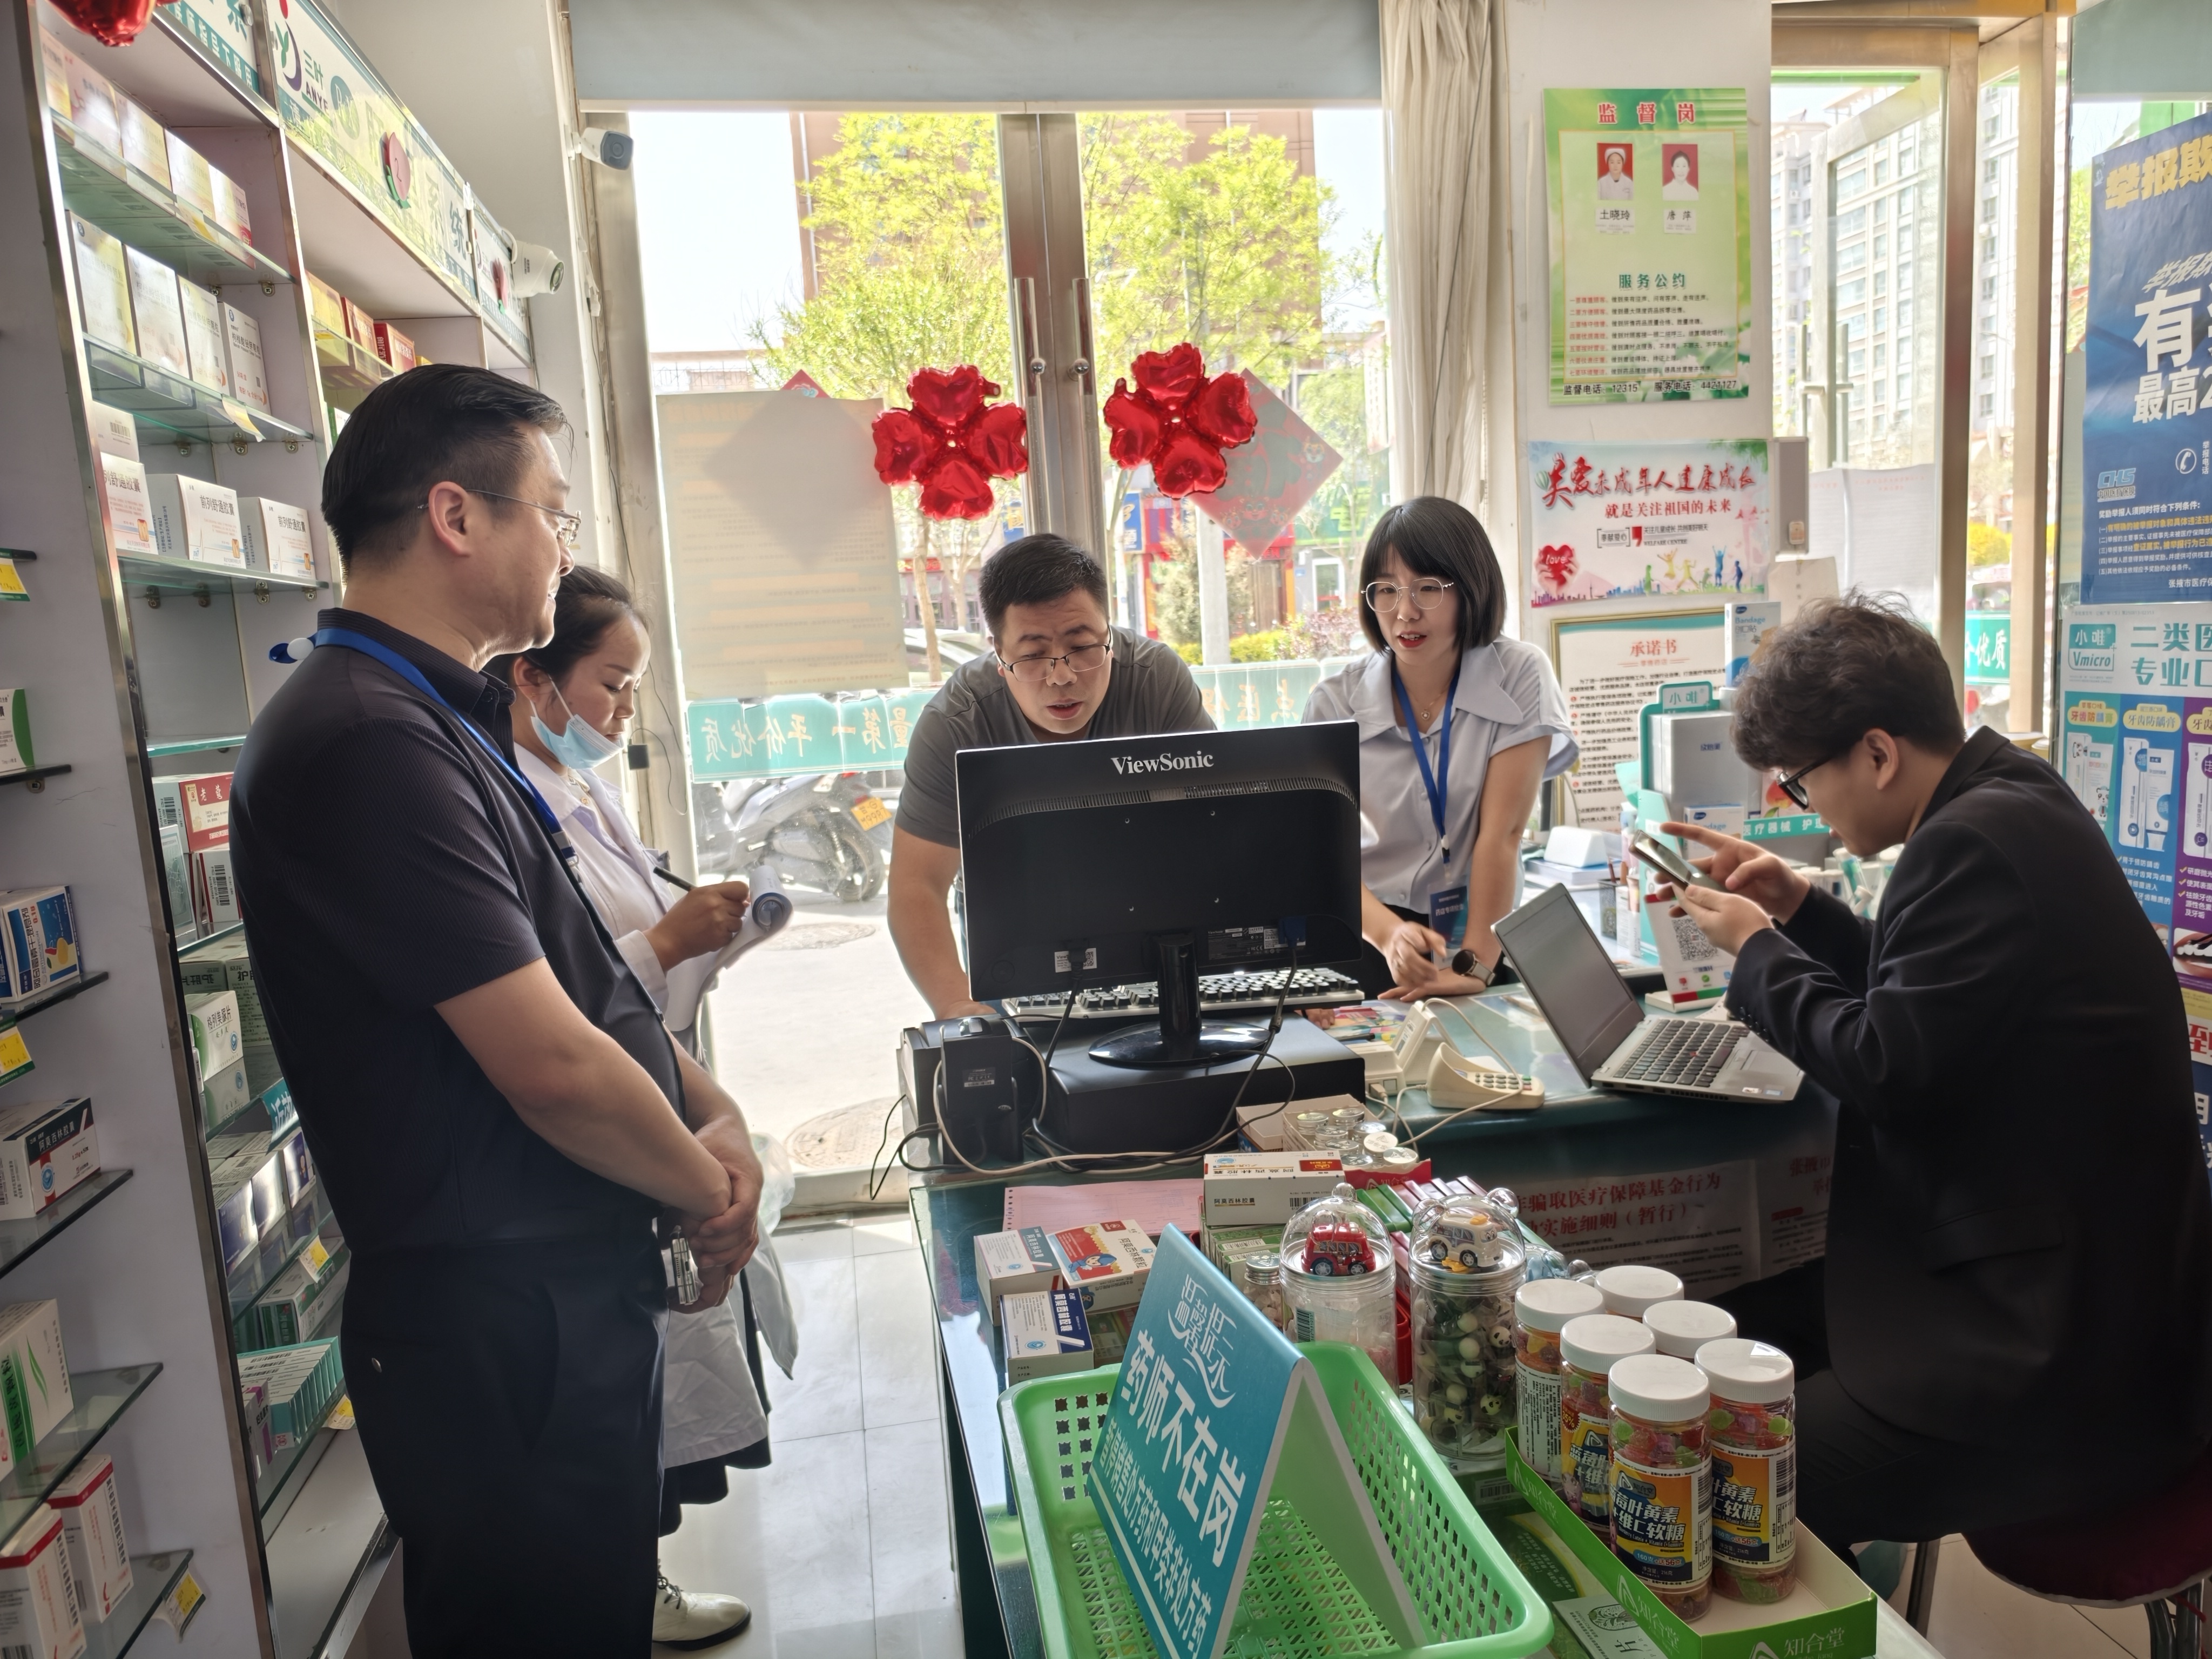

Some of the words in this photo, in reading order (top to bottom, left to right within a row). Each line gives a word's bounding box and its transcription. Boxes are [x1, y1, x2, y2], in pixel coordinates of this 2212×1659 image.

[303, 49, 324, 90] 三叶
[1596, 102, 1696, 125] 监督岗
[1618, 273, 1685, 291] 服务公约
[1612, 383, 1638, 394] 12315
[2201, 440, 2210, 475] 举报电话
[2098, 467, 2136, 489] CHS
[199, 495, 235, 517] 前列舒通胶囊
[1604, 498, 1732, 519] 就是关注祖国的未来
[277, 515, 307, 534] 前列舒通胶囊
[1546, 554, 1566, 566] love
[1735, 616, 1766, 625] Bandage
[1630, 638, 1678, 658] 承诺书
[2073, 651, 2111, 667] Vmicro
[1111, 750, 1215, 775] ViewSonic
[1214, 1197, 1256, 1205] 阿莫西林胶囊
[1118, 1237, 1148, 1269] 阿莫西林颗粒
[1053, 1293, 1074, 1332] 阿莫西林胶囊
[1170, 1273, 1237, 1404] 温馨提示
[1121, 1329, 1246, 1568] 药师不在岗
[1100, 1417, 1212, 1659] 暂停销售处方药和甲类非处方药
[1636, 1552, 1654, 1562] 160克
[1638, 1595, 1680, 1654] 知合堂
[1784, 1627, 1846, 1659] 知合堂
